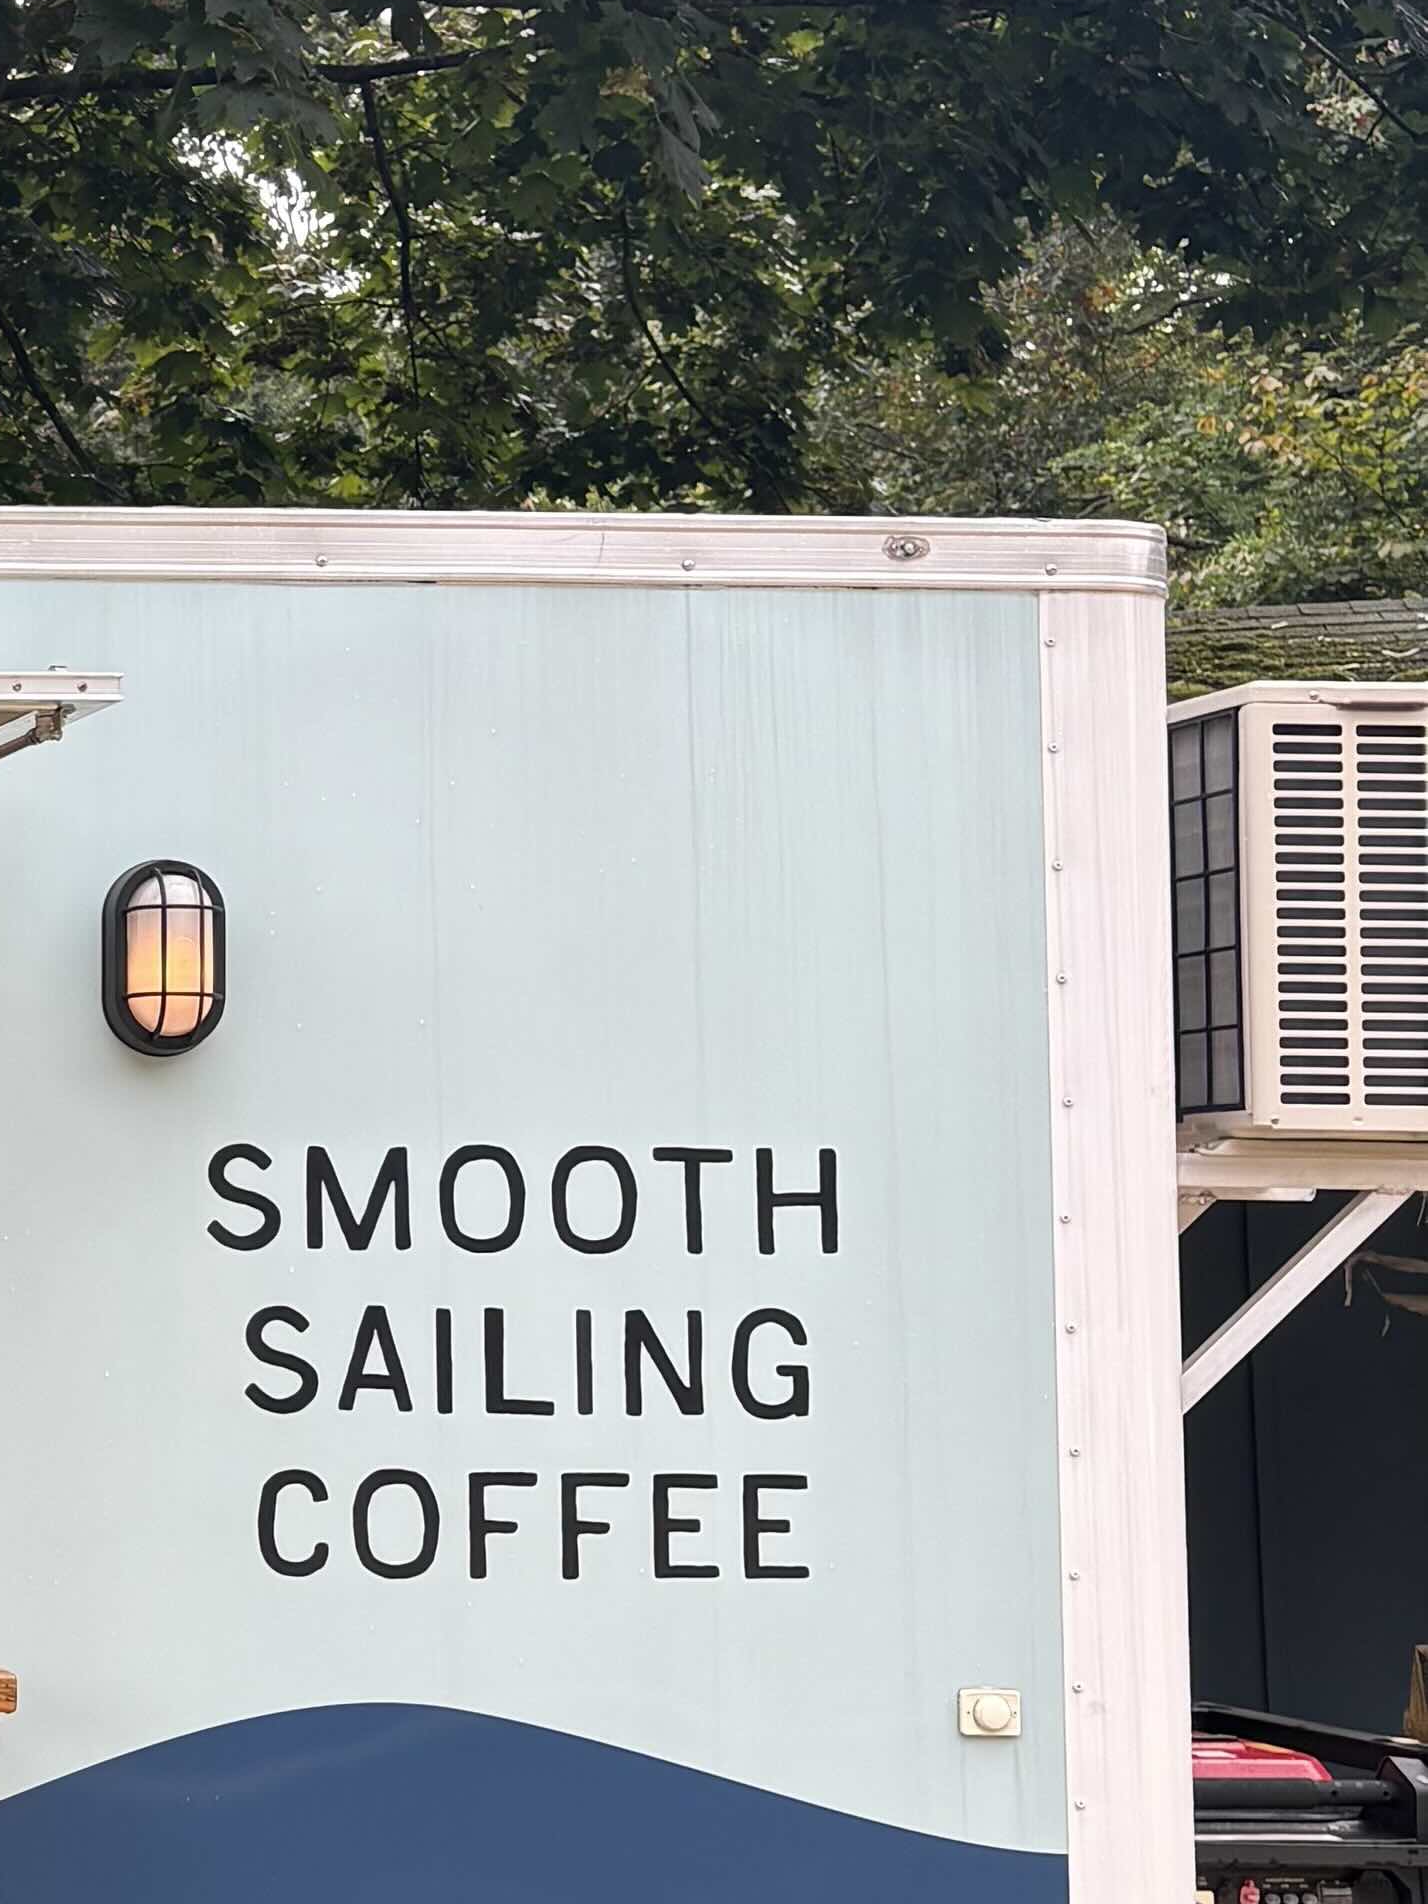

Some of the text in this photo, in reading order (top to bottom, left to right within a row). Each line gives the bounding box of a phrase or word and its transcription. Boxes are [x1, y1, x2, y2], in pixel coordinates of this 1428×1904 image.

[207, 1144, 838, 1255] SMOOTH
[245, 1306, 809, 1419] SAILING
[258, 1469, 809, 1580] COFFEE
